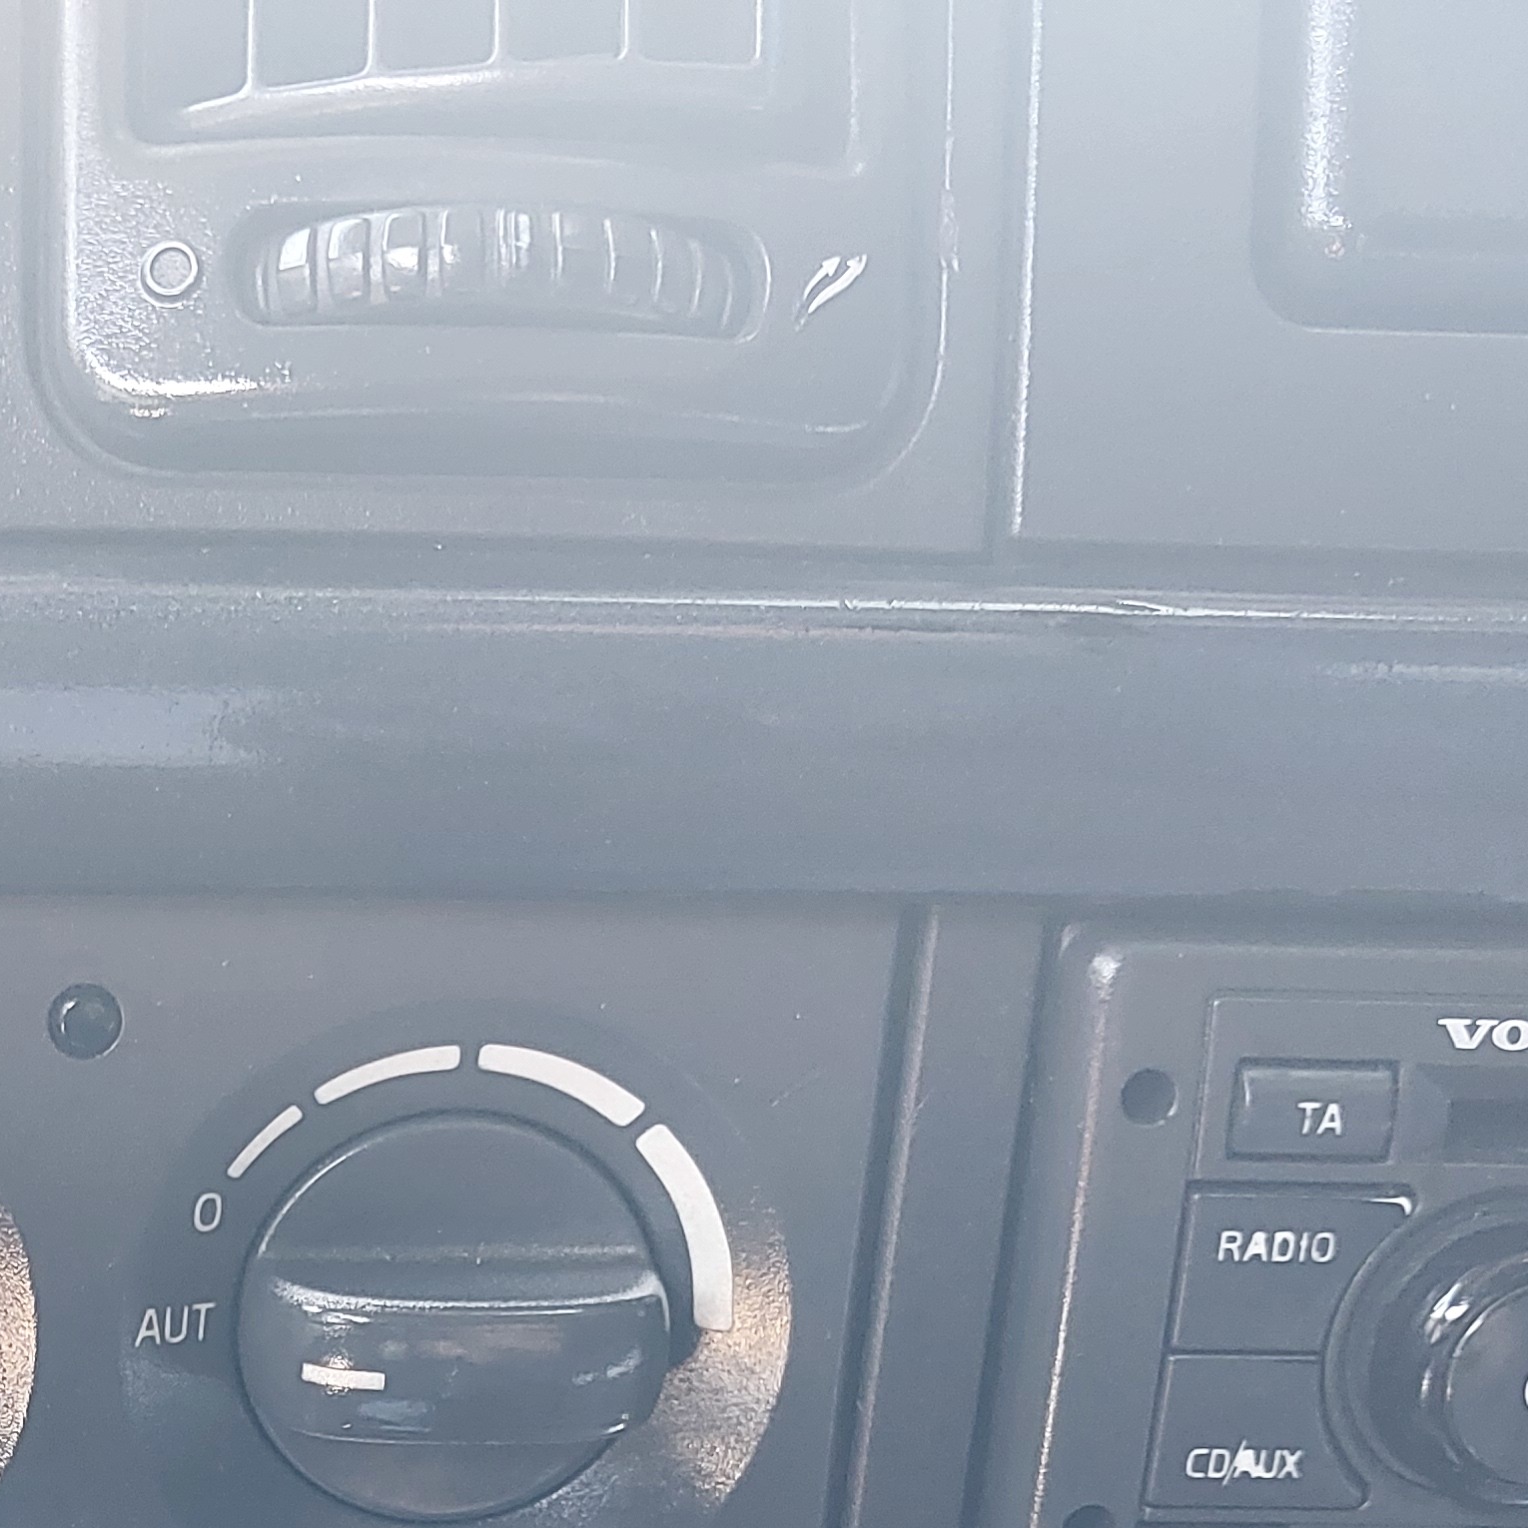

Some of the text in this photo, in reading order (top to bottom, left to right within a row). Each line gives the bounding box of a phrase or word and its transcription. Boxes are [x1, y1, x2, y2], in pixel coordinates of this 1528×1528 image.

[1297, 1101, 1344, 1136] TA
[1217, 1230, 1336, 1263] RADIO
[135, 1303, 216, 1348] AUT
[1185, 1439, 1303, 1486] CD/AUX
